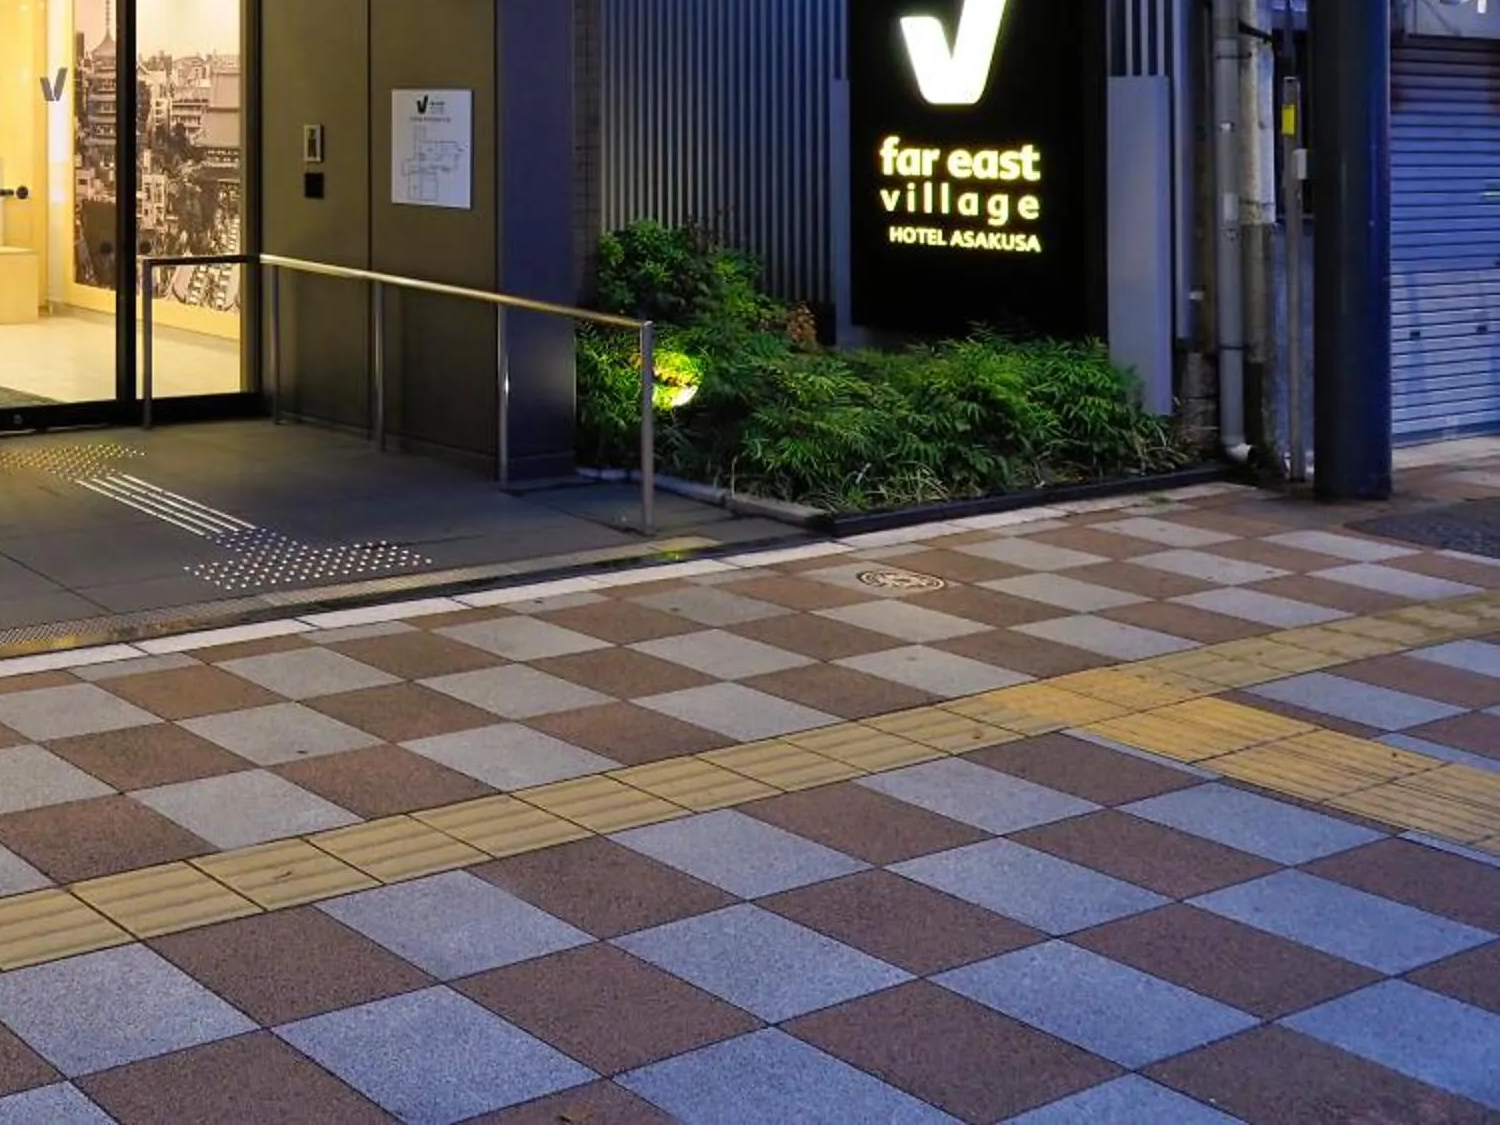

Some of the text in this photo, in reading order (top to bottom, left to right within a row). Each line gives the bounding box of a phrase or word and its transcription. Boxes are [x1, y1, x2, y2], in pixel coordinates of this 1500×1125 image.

[879, 135, 1041, 181] far east
[880, 181, 1040, 225] village
[889, 227, 1041, 253] HOTEL ASAKUSA
